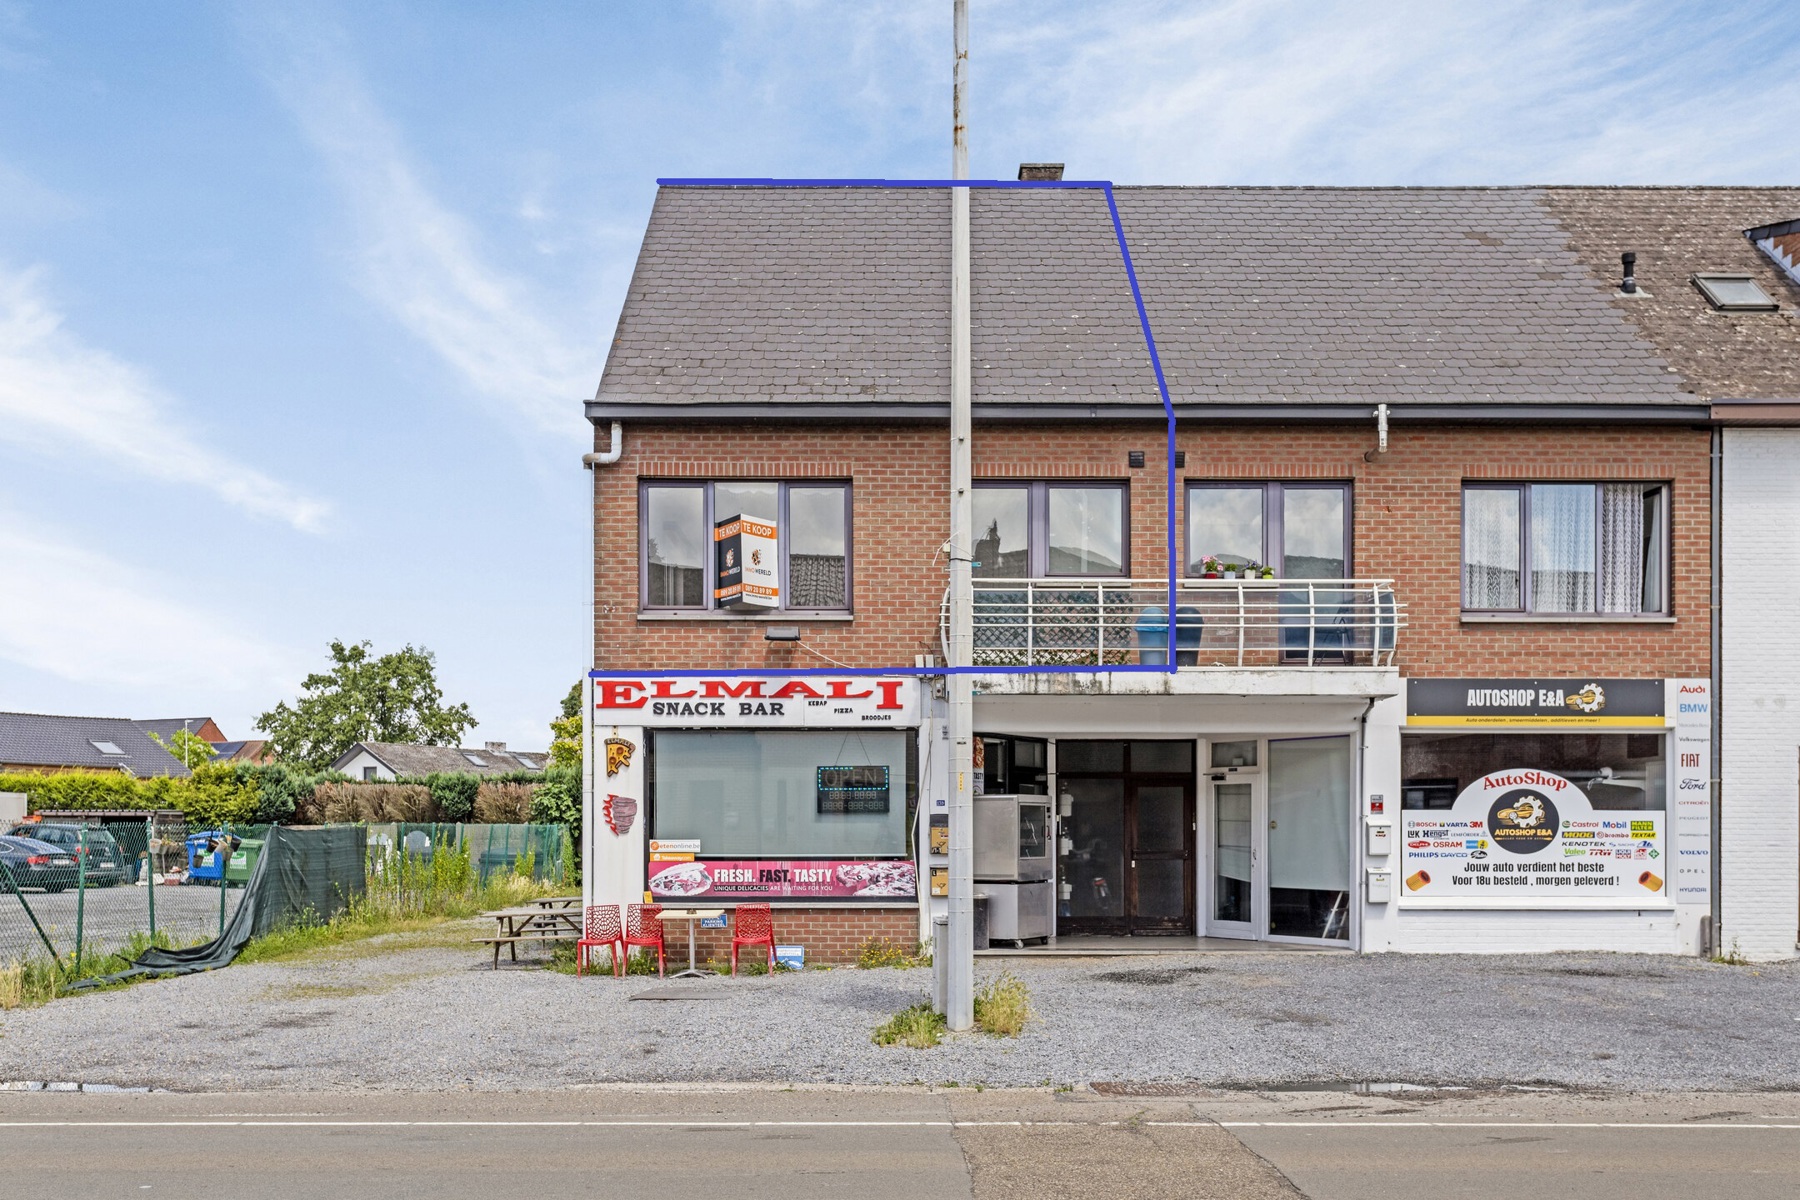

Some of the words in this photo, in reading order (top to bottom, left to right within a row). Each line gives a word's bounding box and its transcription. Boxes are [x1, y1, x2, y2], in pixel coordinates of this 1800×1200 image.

[719, 528, 725, 538] TE
[726, 523, 740, 535] KOOP
[743, 522, 750, 533] TE
[752, 524, 772, 536] KOOP
[596, 680, 903, 710] ELMALI
[1680, 685, 1706, 694] Audi
[1467, 689, 1535, 706] AUTOSHOP
[1538, 689, 1564, 706] E&A
[652, 702, 726, 716] SNACK
[738, 702, 784, 716] BAR
[1680, 704, 1708, 712] BMW
[1681, 754, 1700, 768] FIAT
[825, 768, 877, 786] OPEN
[1484, 772, 1568, 792] AutoShop
[1680, 778, 1706, 790] Ford
[1423, 830, 1449, 838] Hengst
[1464, 862, 1490, 872] Jouw
[1493, 863, 1514, 872] auto
[1517, 862, 1556, 872] verdient
[1559, 862, 1574, 872] het
[1578, 862, 1604, 872] beste
[714, 869, 756, 882] FRESH.
[760, 869, 791, 882] FAST.
[794, 869, 832, 882] TASTY
[1452, 876, 1472, 885] Voor
[1475, 876, 1491, 885] 18u
[1493, 876, 1528, 885] besteld
[1536, 876, 1571, 886] morgen
[1574, 876, 1614, 886] geleverd
[1616, 876, 1619, 886] !
